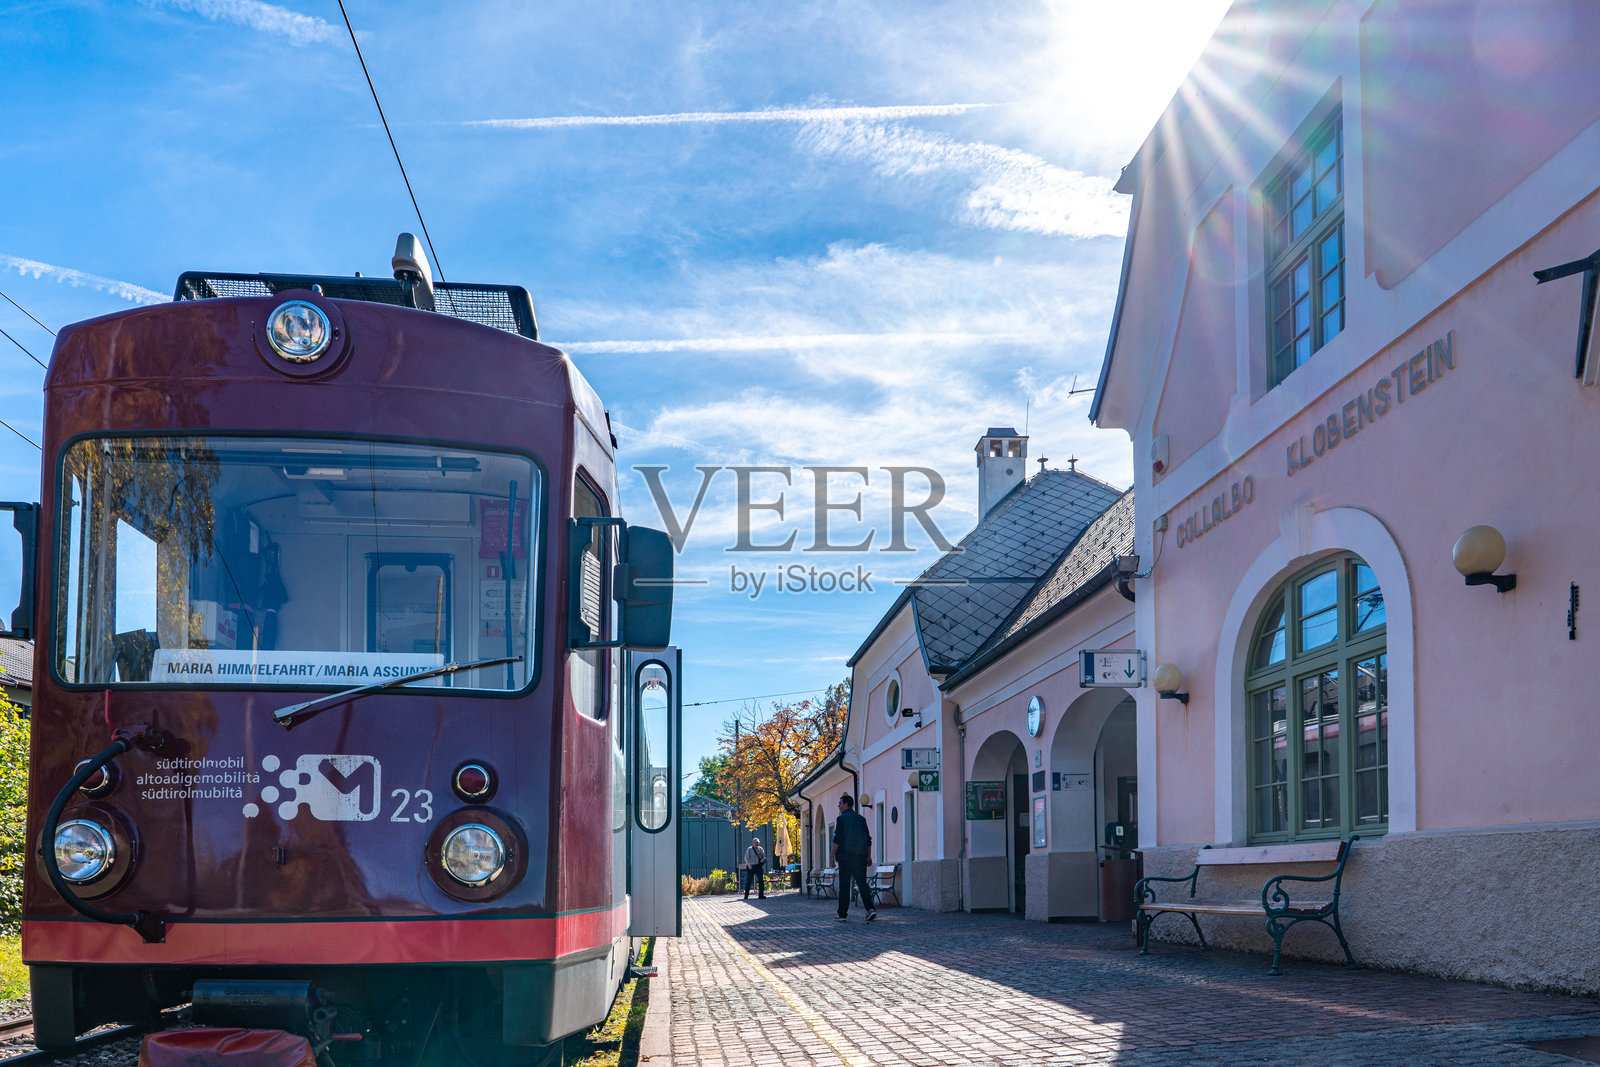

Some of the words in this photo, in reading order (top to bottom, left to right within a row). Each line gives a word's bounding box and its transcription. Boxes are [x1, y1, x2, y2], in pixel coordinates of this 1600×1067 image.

[1177, 475, 1255, 549] COLLALBO
[1286, 330, 1456, 477] KLOBENSTEIN
[167, 662, 213, 675] MARIA
[156, 757, 244, 770] südtirolmobil
[136, 771, 260, 786] altoadigemobilità
[141, 787, 243, 800] südtirolmubiltà
[390, 788, 434, 824] 23
